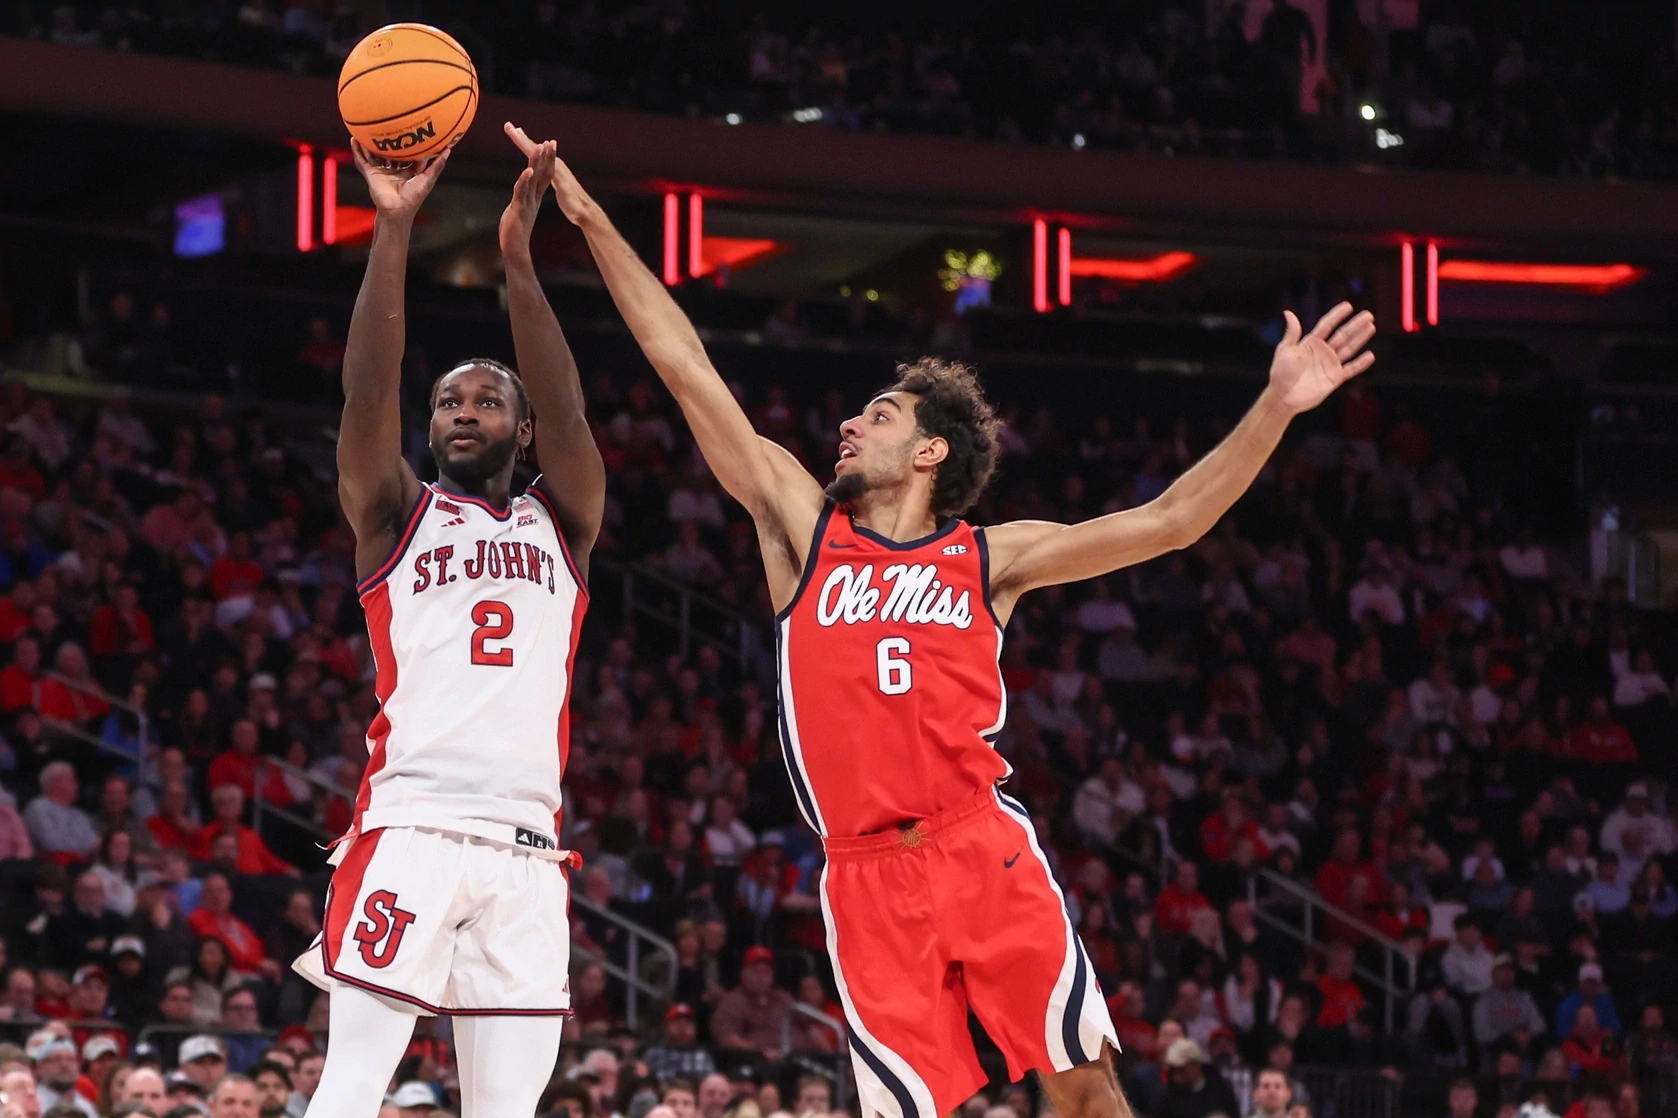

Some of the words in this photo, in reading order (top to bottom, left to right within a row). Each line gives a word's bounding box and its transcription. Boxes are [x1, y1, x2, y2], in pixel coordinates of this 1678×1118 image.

[371, 121, 436, 151] NCAA
[517, 514, 533, 522] BIG
[517, 518, 539, 527] EAST
[412, 544, 457, 596] ST.
[464, 540, 555, 595] JOHN'S
[942, 544, 968, 556] SEC
[816, 564, 881, 627] Ole
[880, 564, 973, 629] Miss
[471, 600, 513, 667] 2
[876, 636, 912, 695] 6
